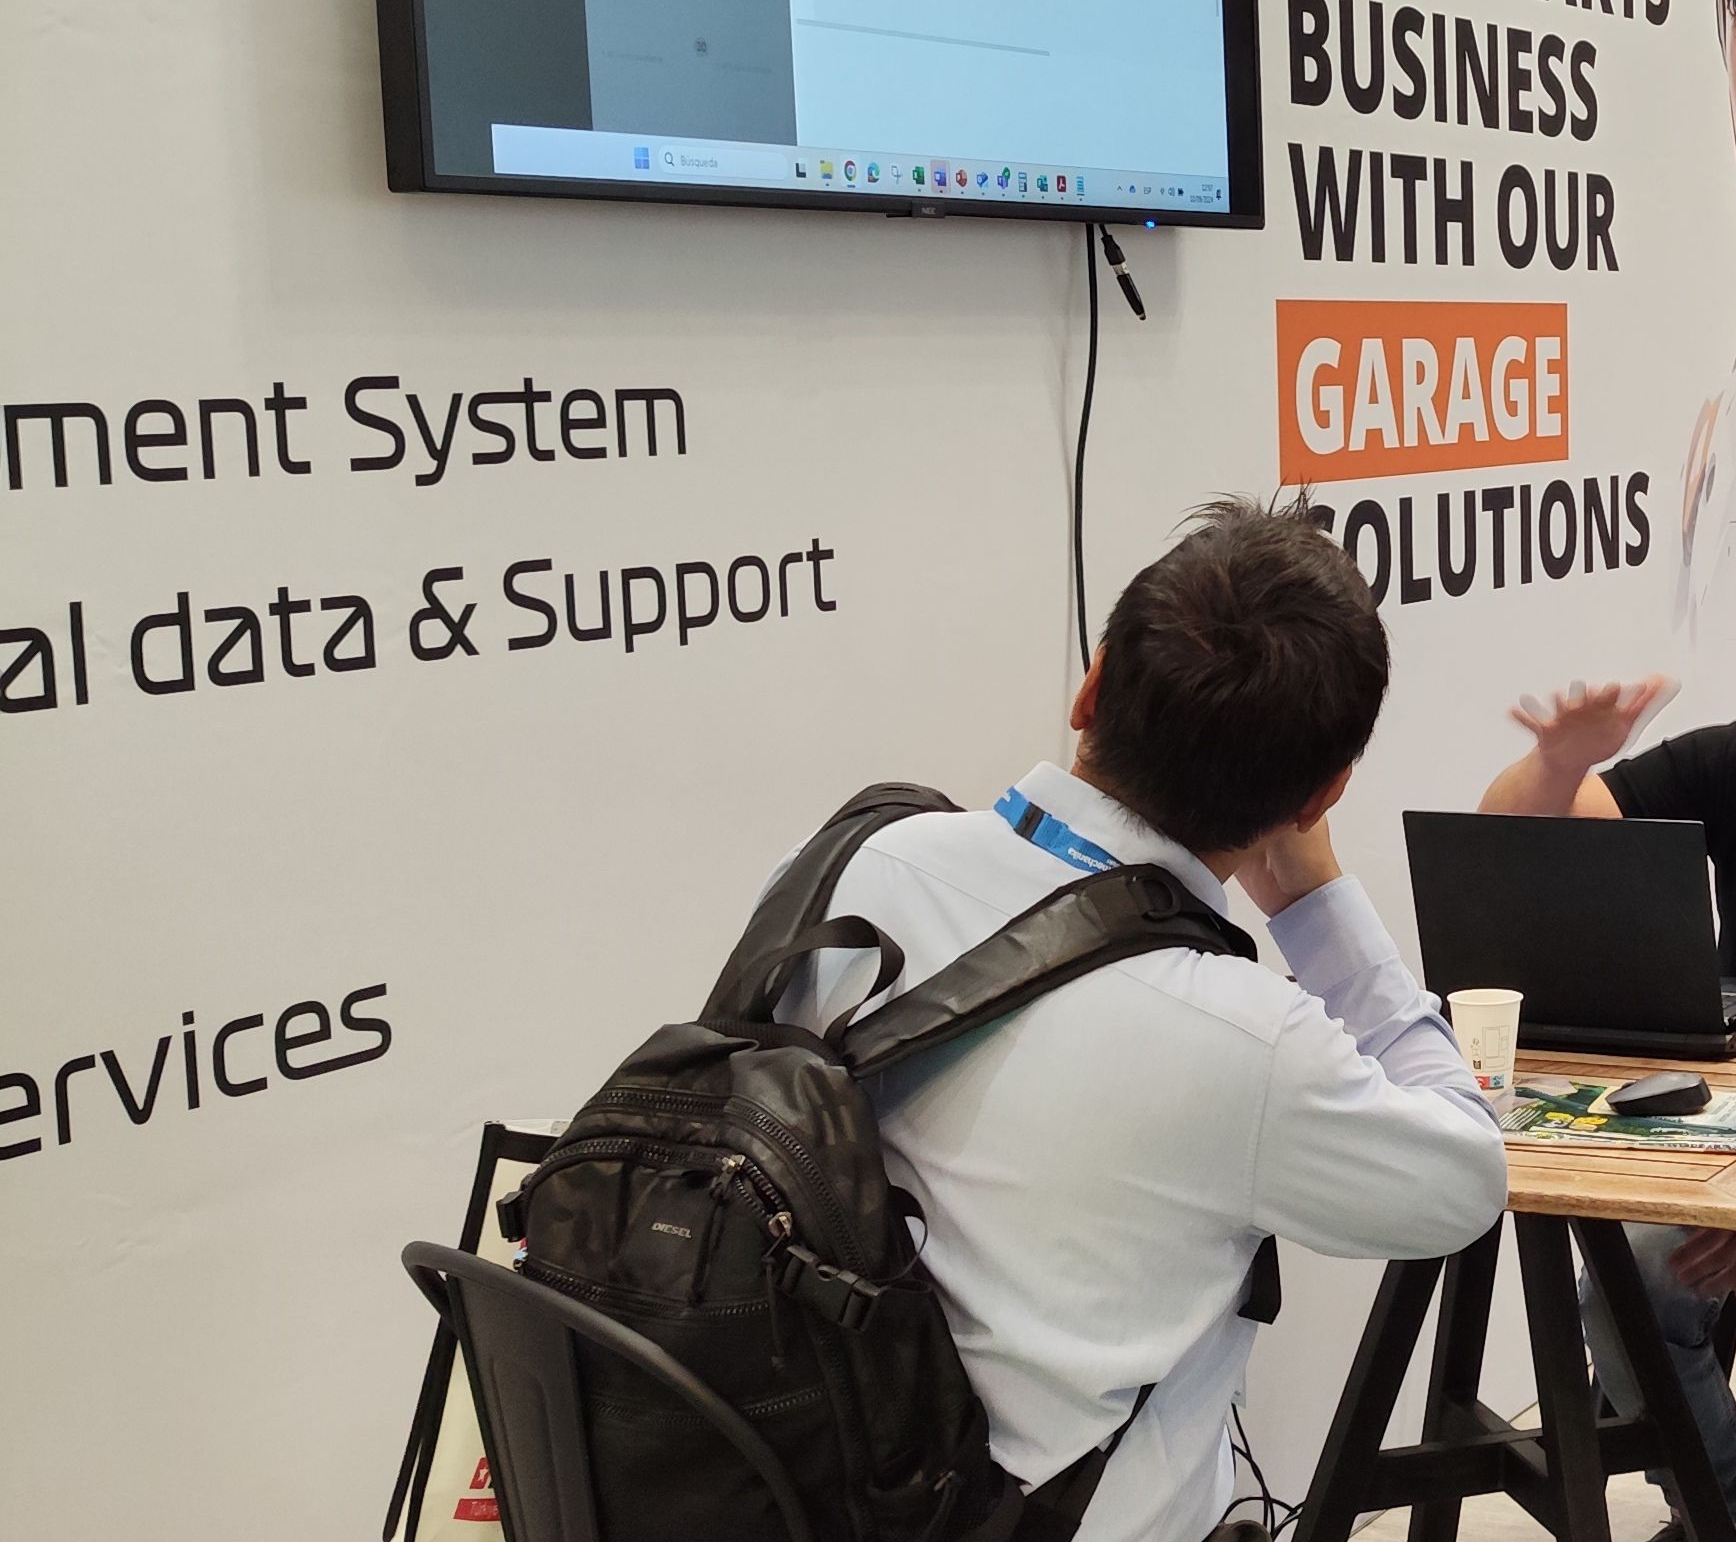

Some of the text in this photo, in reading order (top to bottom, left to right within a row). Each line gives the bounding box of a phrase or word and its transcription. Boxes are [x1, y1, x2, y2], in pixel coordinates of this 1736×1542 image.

[1287, 141, 1620, 272] WITH OUR
[1, 375, 688, 491] ment System
[1295, 334, 1563, 456] GARAGE
[0, 537, 838, 715] al data & Support
[0, 982, 393, 1161] ervices
[651, 1222, 692, 1239] DIESEL
